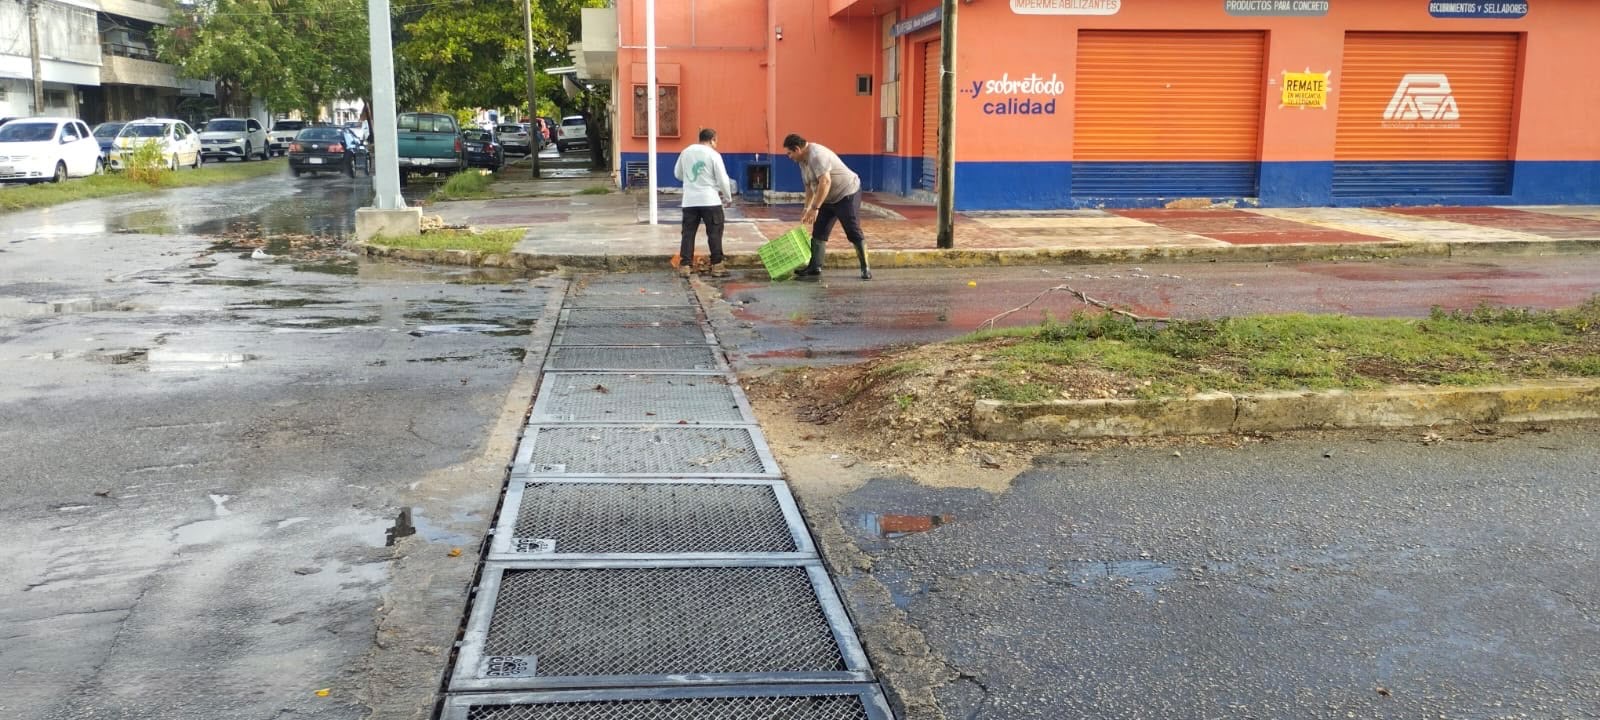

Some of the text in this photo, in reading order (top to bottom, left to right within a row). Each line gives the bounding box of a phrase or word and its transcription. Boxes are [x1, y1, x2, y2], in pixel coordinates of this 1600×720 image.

[1014, 0, 1117, 9] IMPERMEABILIZANTES
[1226, 0, 1329, 11] PRODUCTOS PARA CONCRETO
[1484, 3, 1527, 14] SELLADORES
[1286, 79, 1323, 92] REMATE
[983, 98, 1056, 115] calidad
